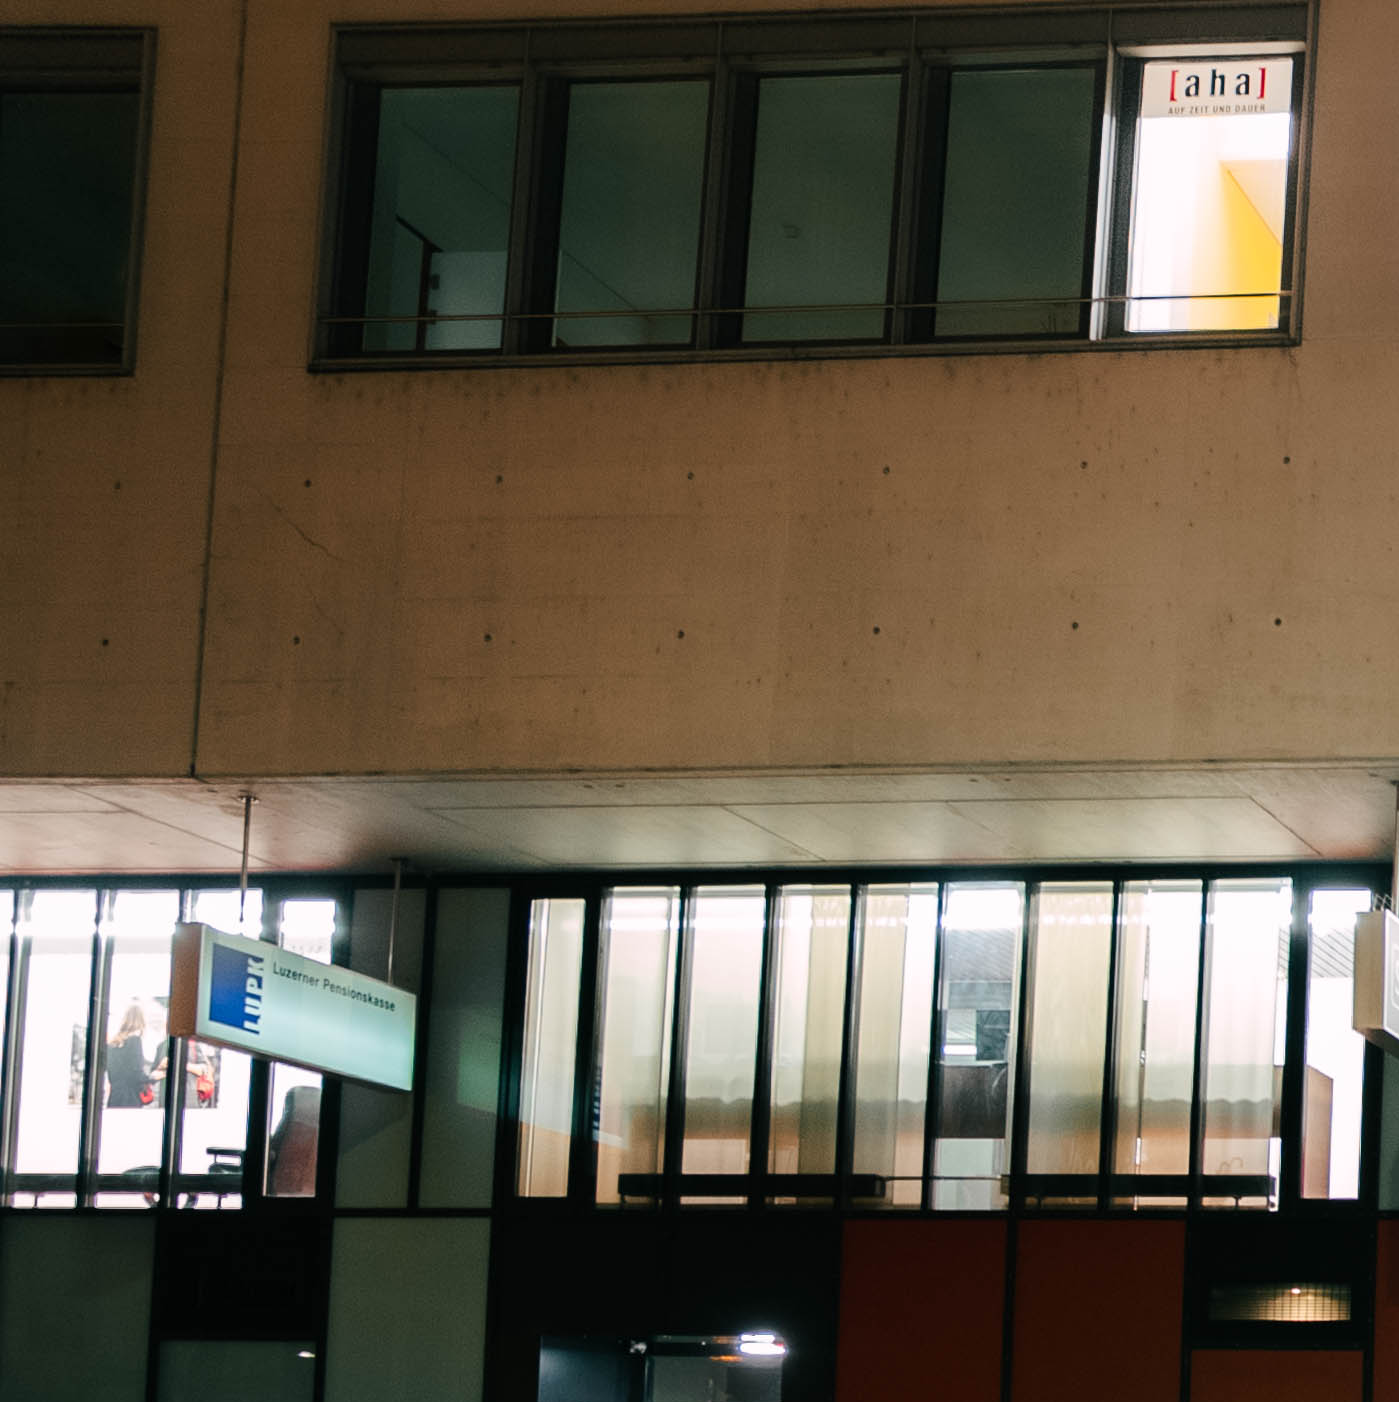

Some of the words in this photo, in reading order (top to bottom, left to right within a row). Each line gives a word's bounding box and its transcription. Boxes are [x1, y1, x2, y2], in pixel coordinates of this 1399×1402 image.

[1170, 67, 1267, 102] [aha]
[1168, 106, 1186, 115] AUF
[1189, 105, 1209, 114] ZEIT
[1212, 104, 1231, 114] UND
[1234, 104, 1266, 113] DAUER
[272, 961, 320, 991] Luzerner
[322, 978, 396, 1012] Pensionskasse
